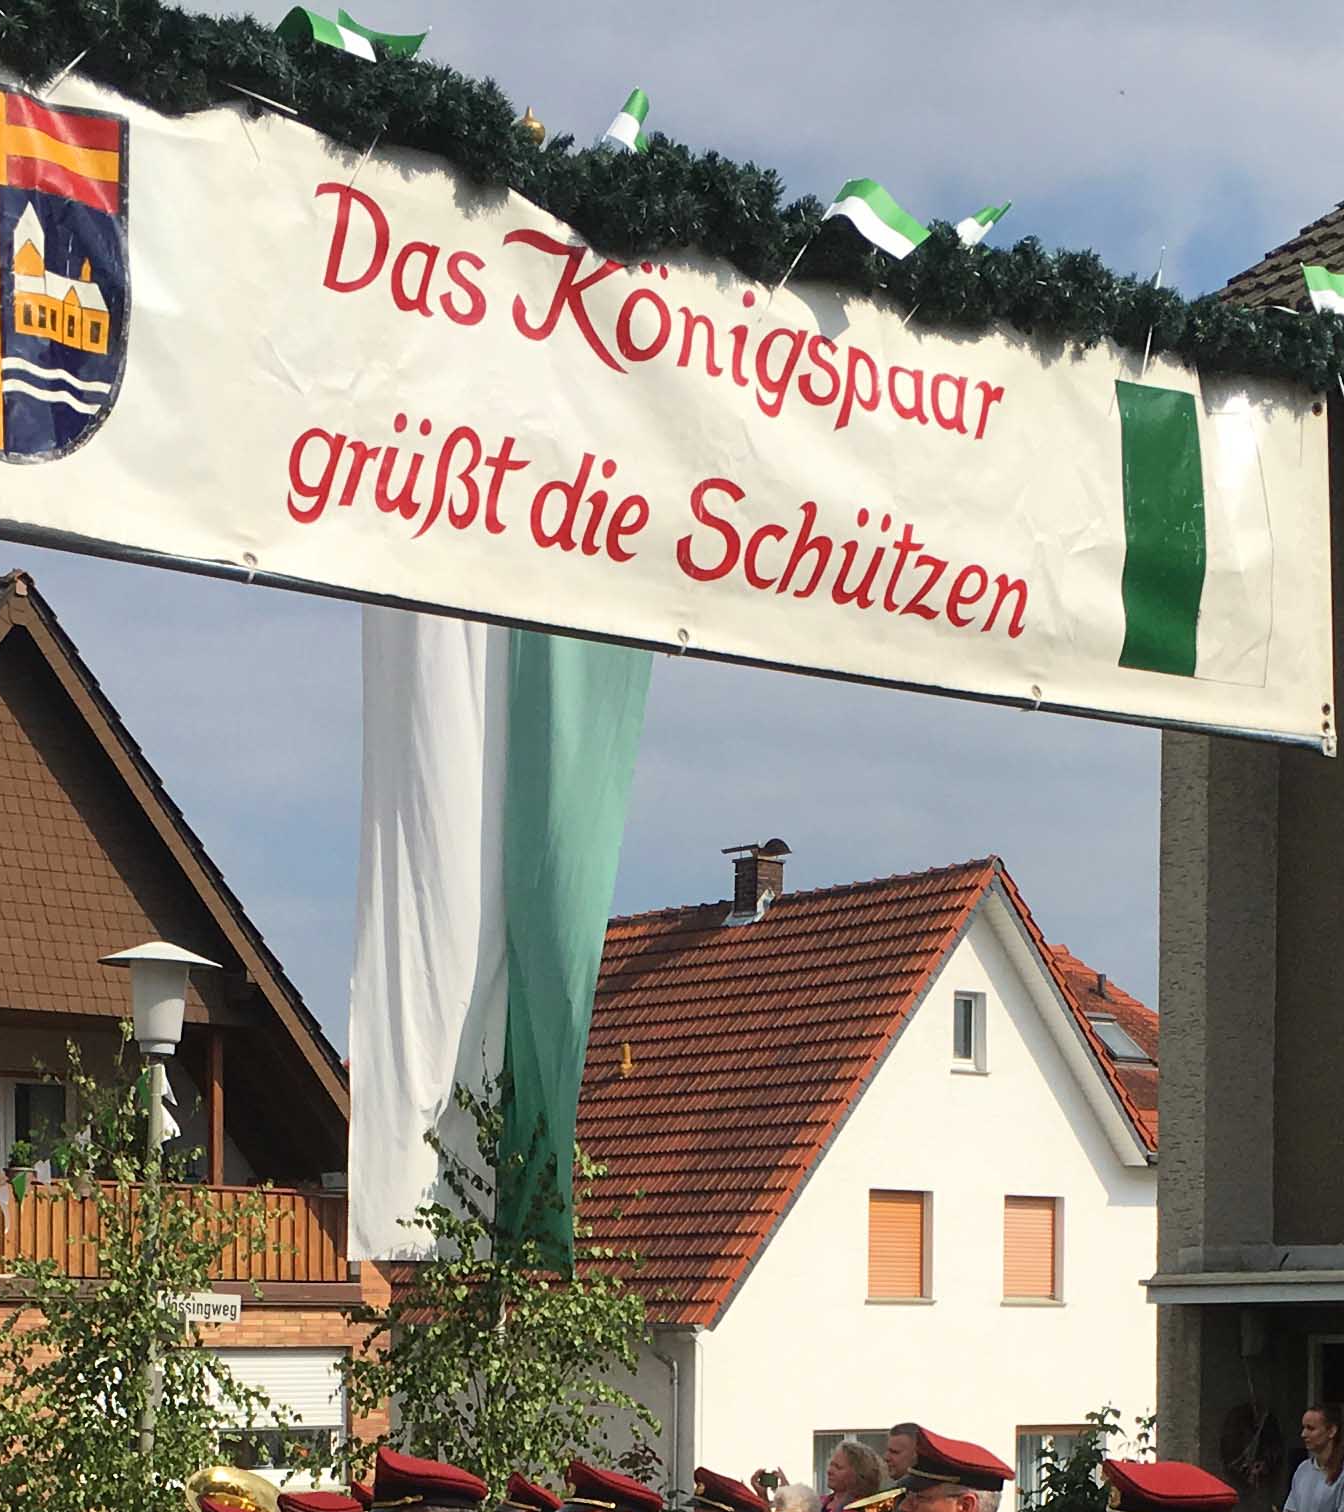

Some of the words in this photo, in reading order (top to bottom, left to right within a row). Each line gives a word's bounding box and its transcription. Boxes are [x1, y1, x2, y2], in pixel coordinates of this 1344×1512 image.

[315, 181, 487, 327] Das
[504, 229, 1005, 440] Königspaar
[287, 412, 529, 537] grüßt
[529, 452, 650, 564] die
[676, 477, 1029, 640] Schützen
